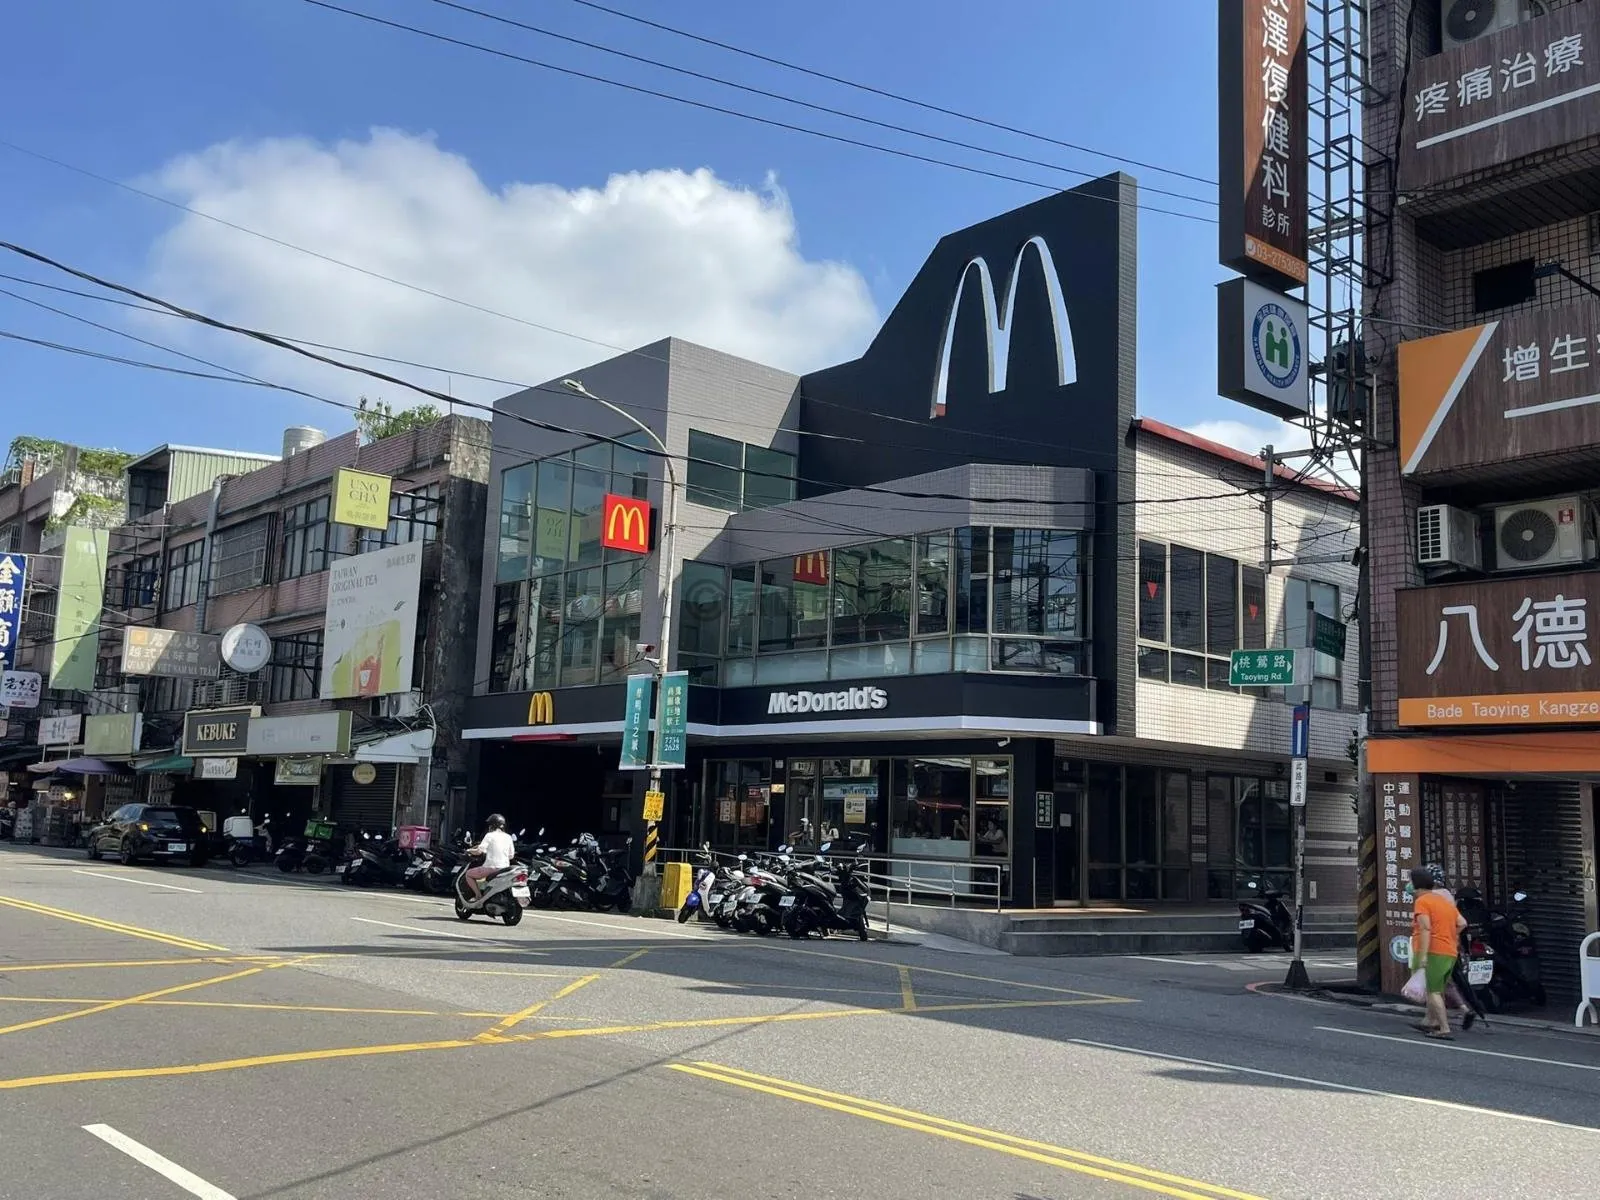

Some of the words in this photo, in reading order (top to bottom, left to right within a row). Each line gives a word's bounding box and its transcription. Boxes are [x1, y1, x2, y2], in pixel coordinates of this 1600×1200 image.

[1415, 33, 1584, 122] 疼痛治療
[1262, 0, 1290, 208] 澤復健科
[1262, 204, 1290, 237] 診所
[1502, 334, 1600, 383] 增生
[350, 480, 379, 493] UNO
[350, 490, 377, 504] CHA
[1426, 594, 1592, 676] 八德
[1239, 655, 1286, 669] 桃鶯路
[1241, 672, 1269, 683] Taoying
[767, 686, 888, 714] McDonald's
[1427, 704, 1463, 719] Bade
[1472, 702, 1529, 718] Taoying
[1539, 700, 1600, 717] Kangze
[197, 722, 238, 742] KEBUKE
[1383, 782, 1399, 904] 中風與心肺復健服務
